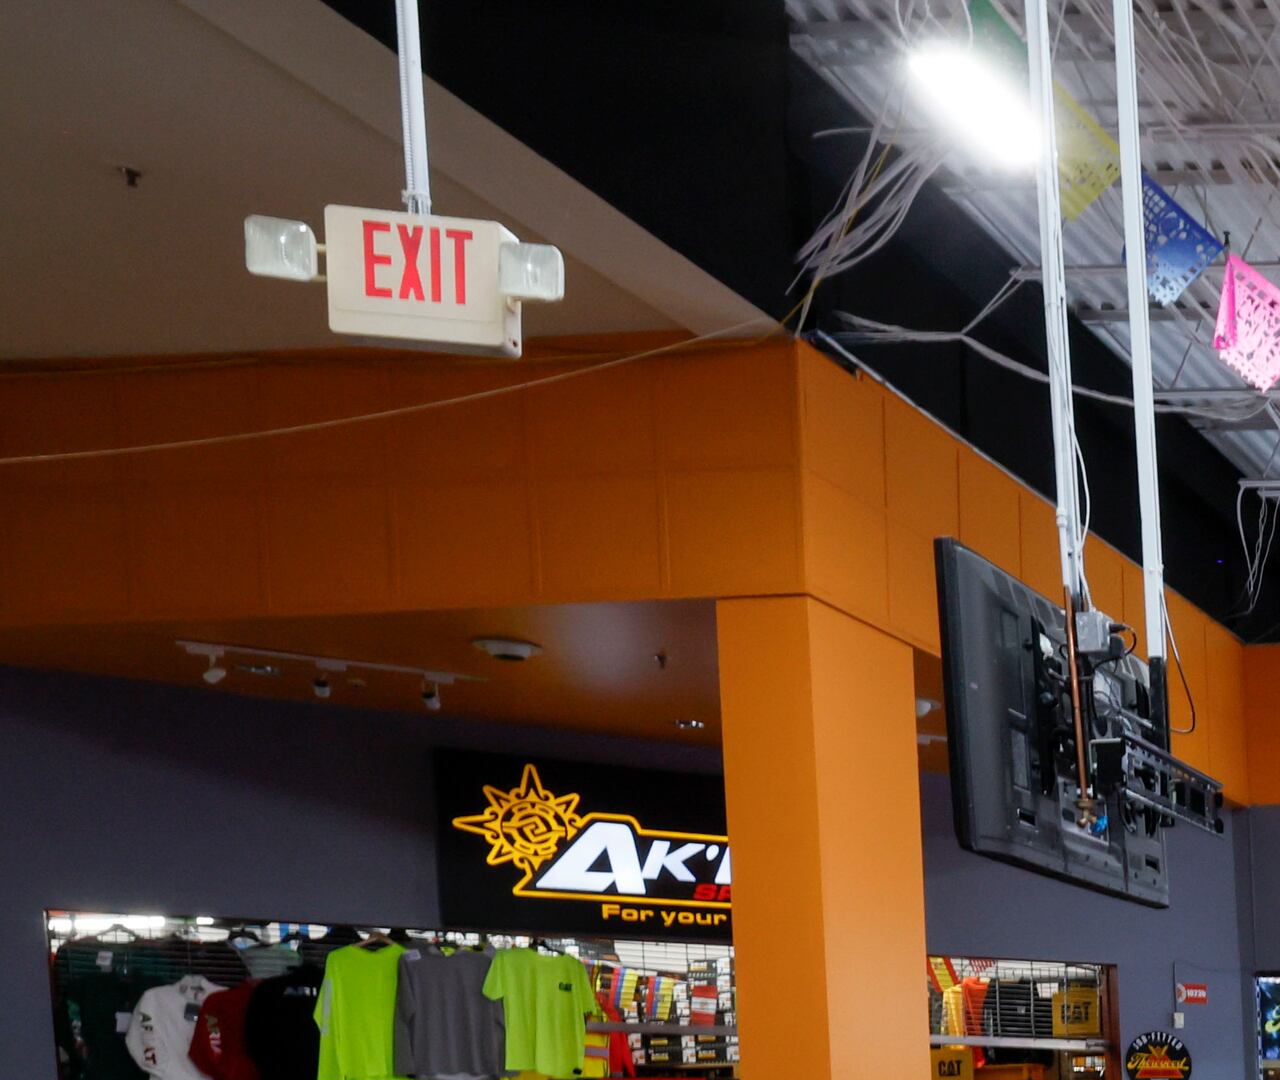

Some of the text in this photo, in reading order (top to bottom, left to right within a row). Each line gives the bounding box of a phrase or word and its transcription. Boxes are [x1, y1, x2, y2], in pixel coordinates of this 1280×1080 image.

[362, 220, 473, 305] EXIT
[602, 903, 727, 927] For your
[1061, 1002, 1092, 1025] CAT
[937, 1059, 963, 1077] CAT
